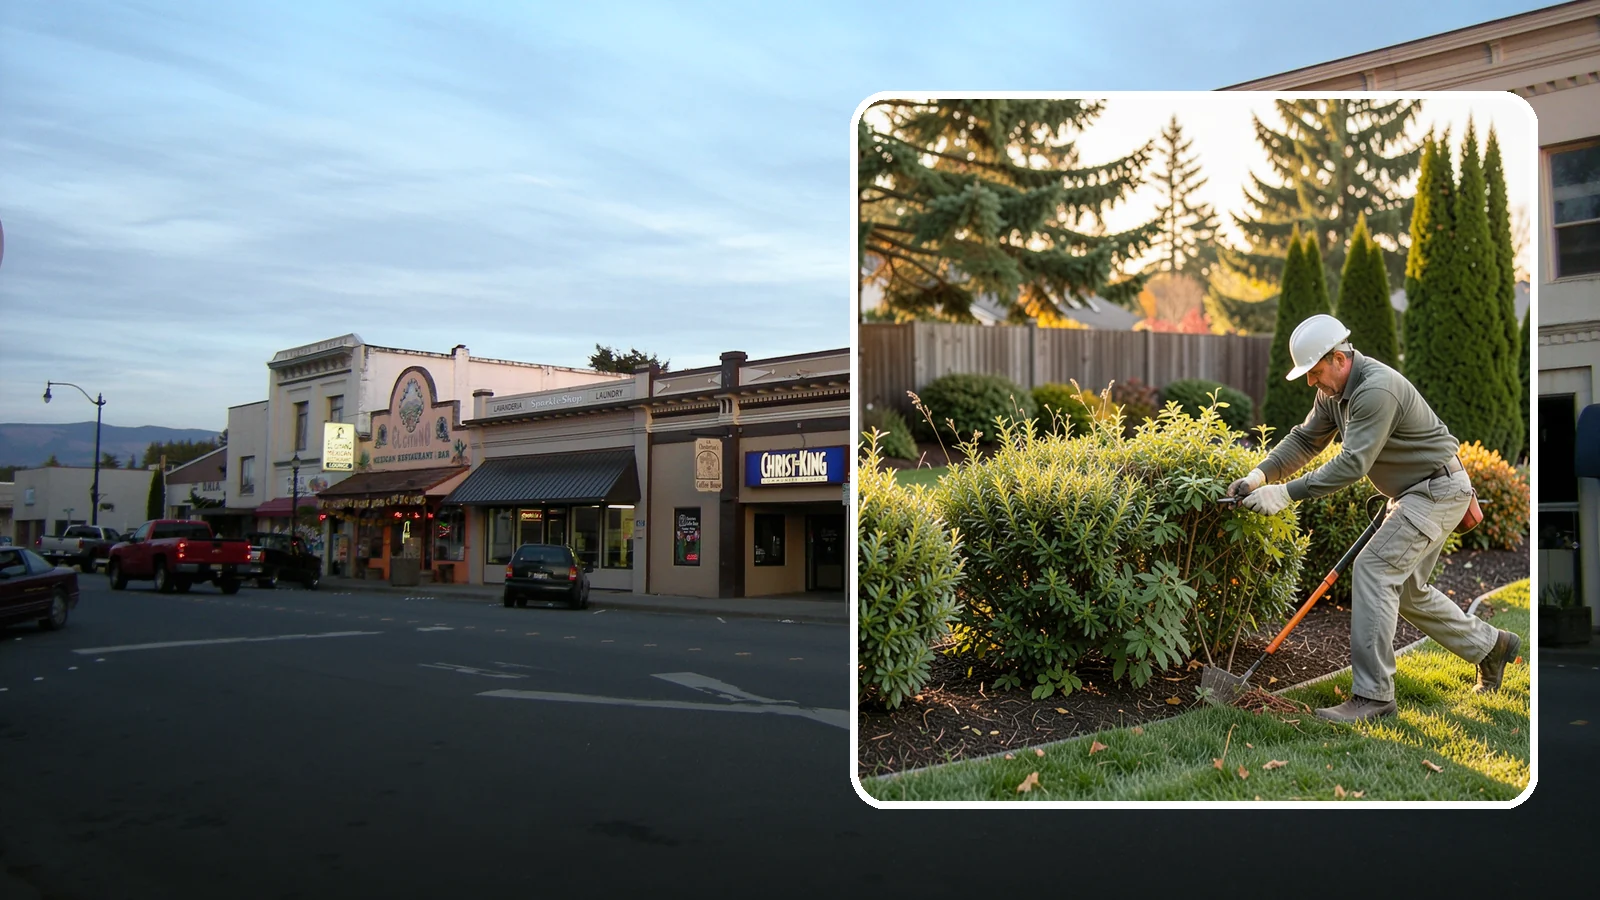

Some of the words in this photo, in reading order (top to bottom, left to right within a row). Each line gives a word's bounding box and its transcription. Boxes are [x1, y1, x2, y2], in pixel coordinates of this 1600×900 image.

[595, 388, 623, 400] LAUNDRY
[493, 401, 523, 412] LAVANDERIA
[531, 398, 561, 409] Sparkle
[561, 394, 582, 405] Shop
[374, 454, 396, 464] MEXICAN
[397, 451, 433, 462] RESTAURANT
[437, 450, 450, 459] BAR
[760, 452, 797, 477] CHRIST
[799, 450, 827, 476] KING
